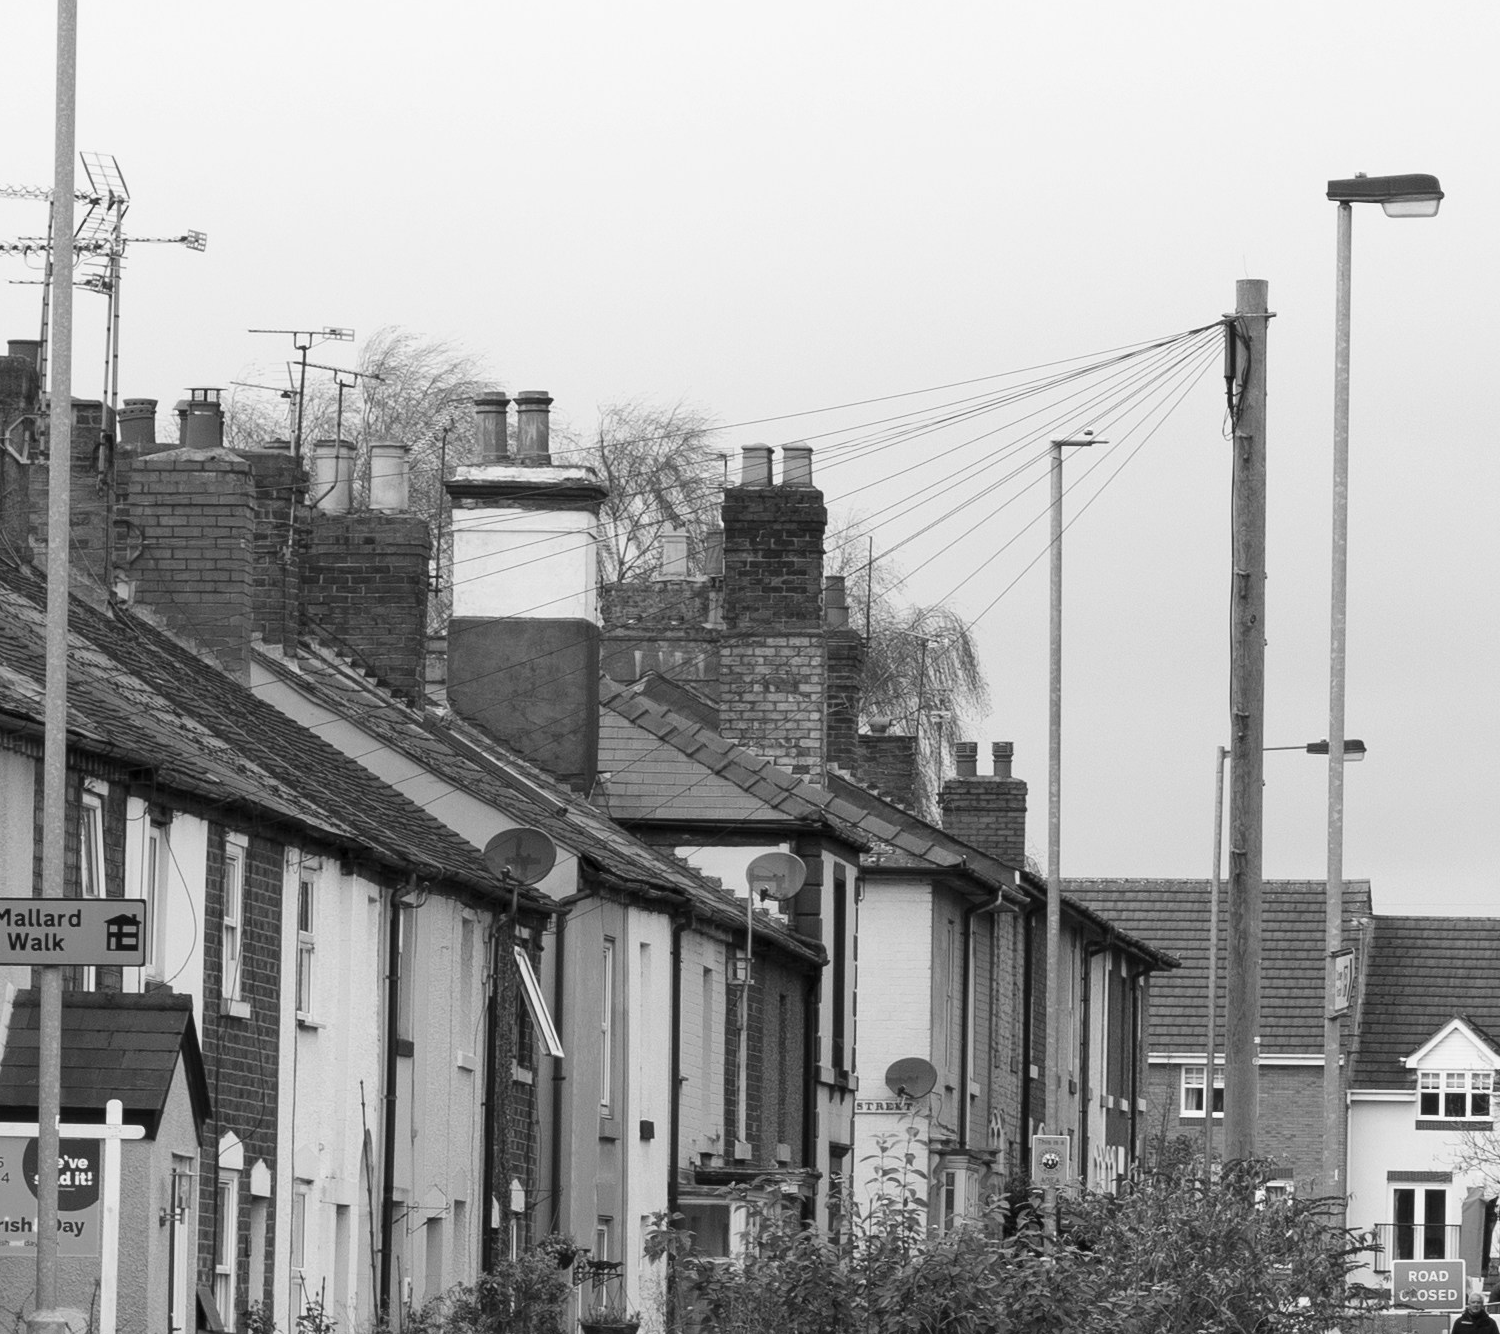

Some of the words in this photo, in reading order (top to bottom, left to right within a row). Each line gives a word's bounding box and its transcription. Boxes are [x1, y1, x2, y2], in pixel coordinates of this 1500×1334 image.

[7, 932, 65, 952] Walk
[74, 1171, 93, 1186] it!
[1408, 1270, 1449, 1282] ROAD
